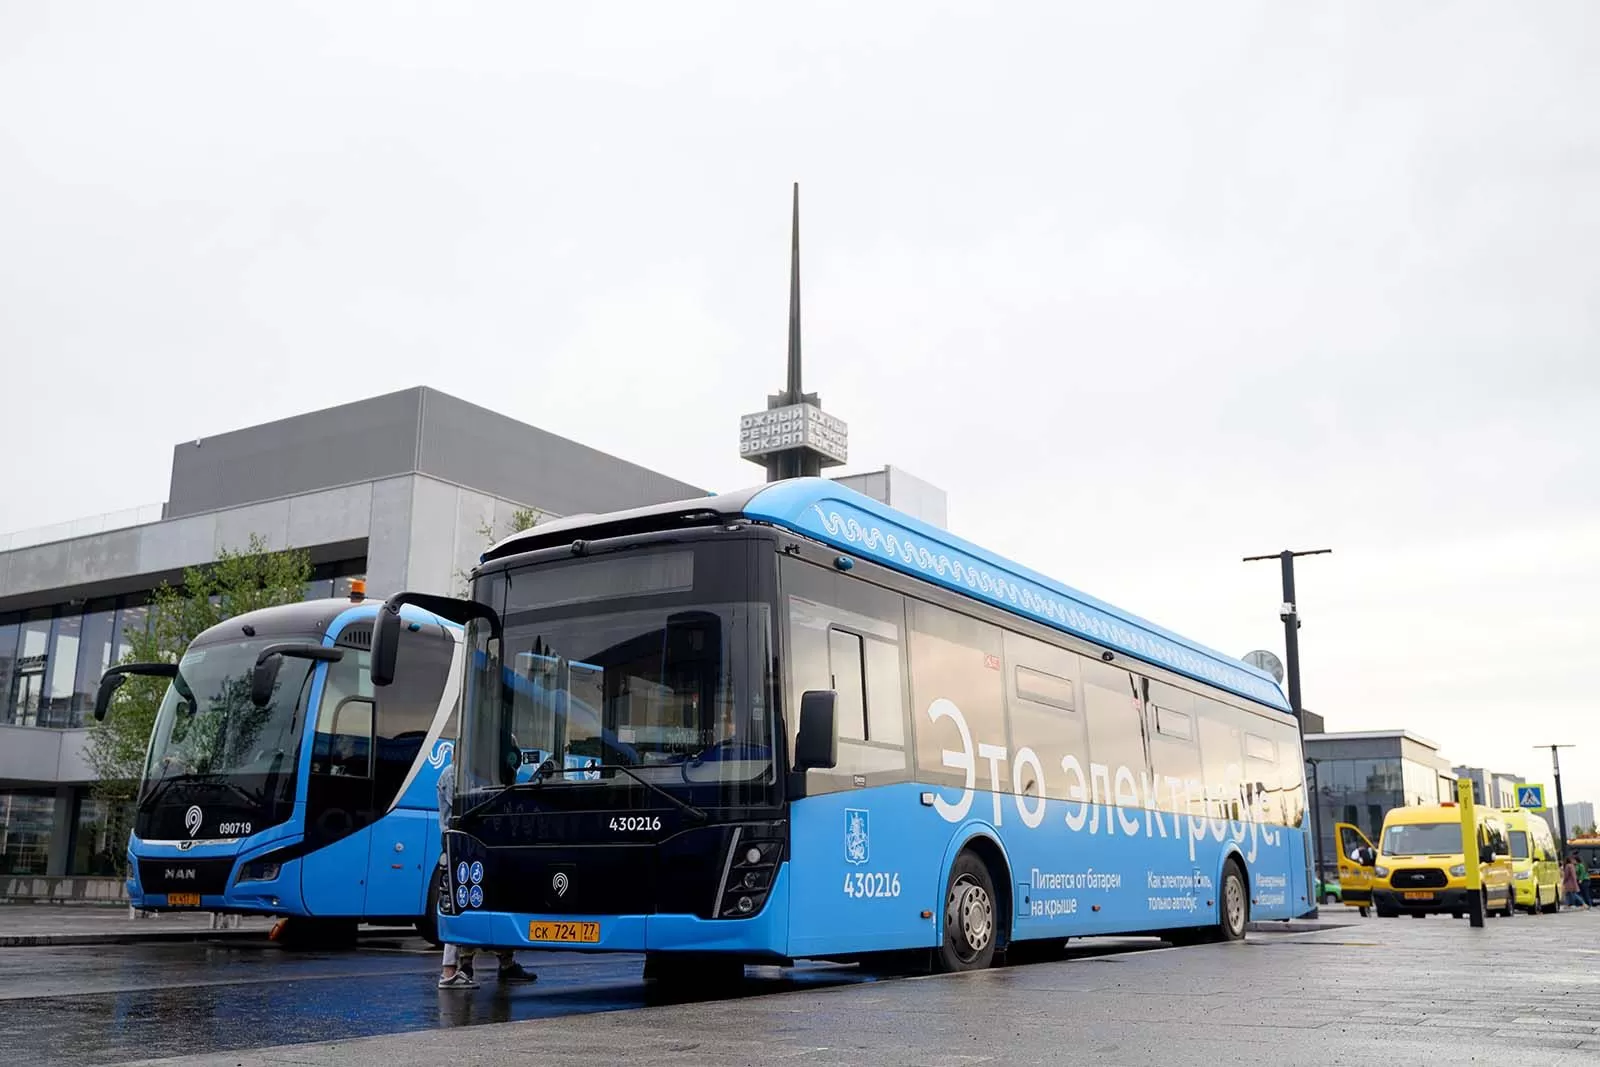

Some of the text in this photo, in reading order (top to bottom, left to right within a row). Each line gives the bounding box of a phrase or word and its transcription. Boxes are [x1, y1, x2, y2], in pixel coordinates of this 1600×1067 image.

[740, 419, 802, 441] РЕЧНОЙ
[740, 431, 802, 452] ВОКЗАЛ
[927, 697, 1046, 829] Это
[219, 822, 252, 834] 090719
[609, 816, 661, 831] 430216
[164, 868, 196, 879] MAN
[1031, 868, 1075, 889] Питается
[1076, 873, 1086, 889] от
[843, 872, 901, 898] 430216
[1031, 898, 1077, 920] на крыше
[554, 924, 576, 940] 724
[583, 924, 595, 936] 77
